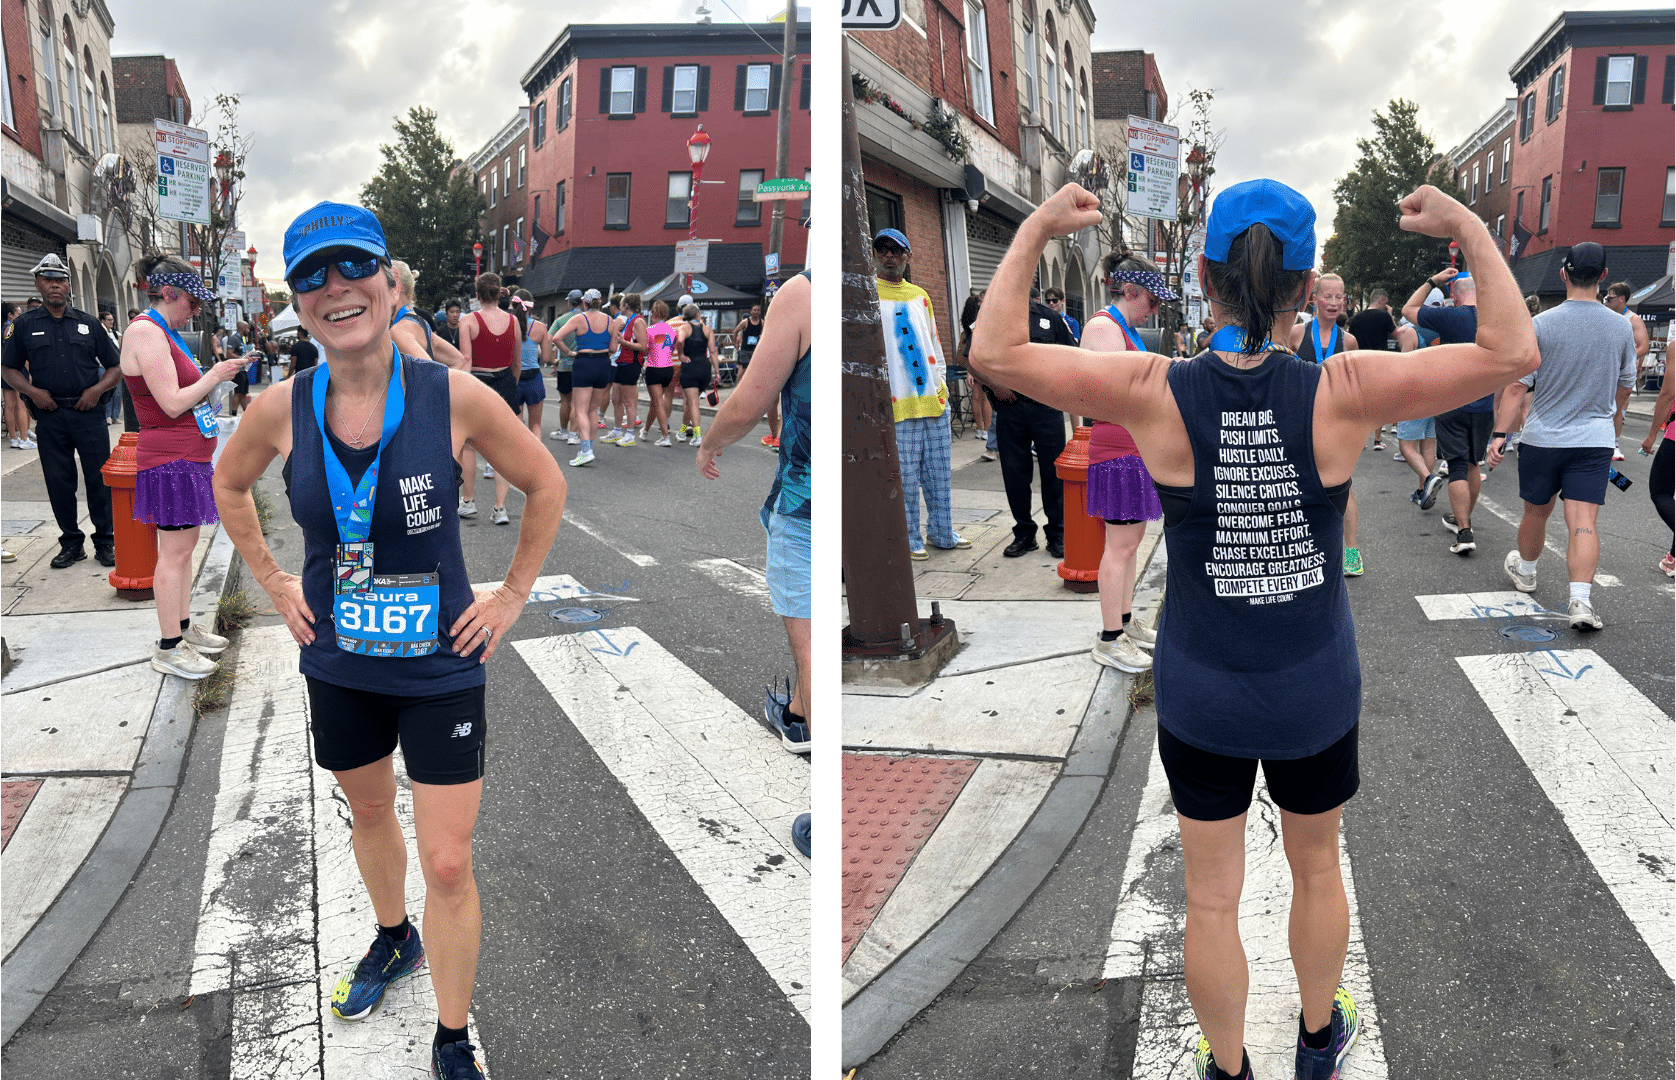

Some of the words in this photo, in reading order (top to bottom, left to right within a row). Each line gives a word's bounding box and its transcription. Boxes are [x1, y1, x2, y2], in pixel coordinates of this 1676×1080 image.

[168, 136, 199, 149] STOPPING
[1140, 133, 1170, 146] STOPPING
[176, 160, 206, 173] RESERVED
[1146, 156, 1176, 169] RESERVED
[177, 170, 206, 182] PARKING
[1147, 166, 1175, 178] PARKING
[757, 183, 796, 193] Passyunk
[304, 216, 344, 236] PHILLY
[1221, 411, 1256, 427] DREAM
[1258, 409, 1276, 426] BIG.
[1220, 429, 1246, 445] PUSH
[1248, 428, 1282, 445] LIMITS.
[1219, 448, 1257, 464] HUSTLE
[1257, 446, 1287, 463] DAILY.
[1213, 466, 1250, 481] IGNORE
[1251, 464, 1299, 481] EXCUSES.
[399, 473, 434, 495] MAKE
[1215, 484, 1258, 499] SILENCE
[1259, 481, 1303, 499] CRITICS.
[403, 493, 429, 513] LIFE
[1217, 502, 1266, 514] CONQUER
[406, 505, 442, 528] COUNT.
[1218, 515, 1275, 529] OVERCOME
[1277, 509, 1308, 526] FEAR.
[1216, 530, 1269, 545] MAXIMUM
[1271, 524, 1312, 543] EFFORT.
[1212, 546, 1248, 560] CHASE
[1249, 539, 1318, 560] EXCELLENCE.
[1205, 562, 1266, 577] ENCOURAGE
[1268, 551, 1327, 575] GREATNESS.
[1217, 579, 1266, 594] COMPETE
[1267, 575, 1299, 593] EVERY
[1249, 597, 1265, 605] MAKE
[1265, 595, 1277, 604] LIFE
[1277, 593, 1294, 603] COUNT
[340, 601, 432, 634] 3167
